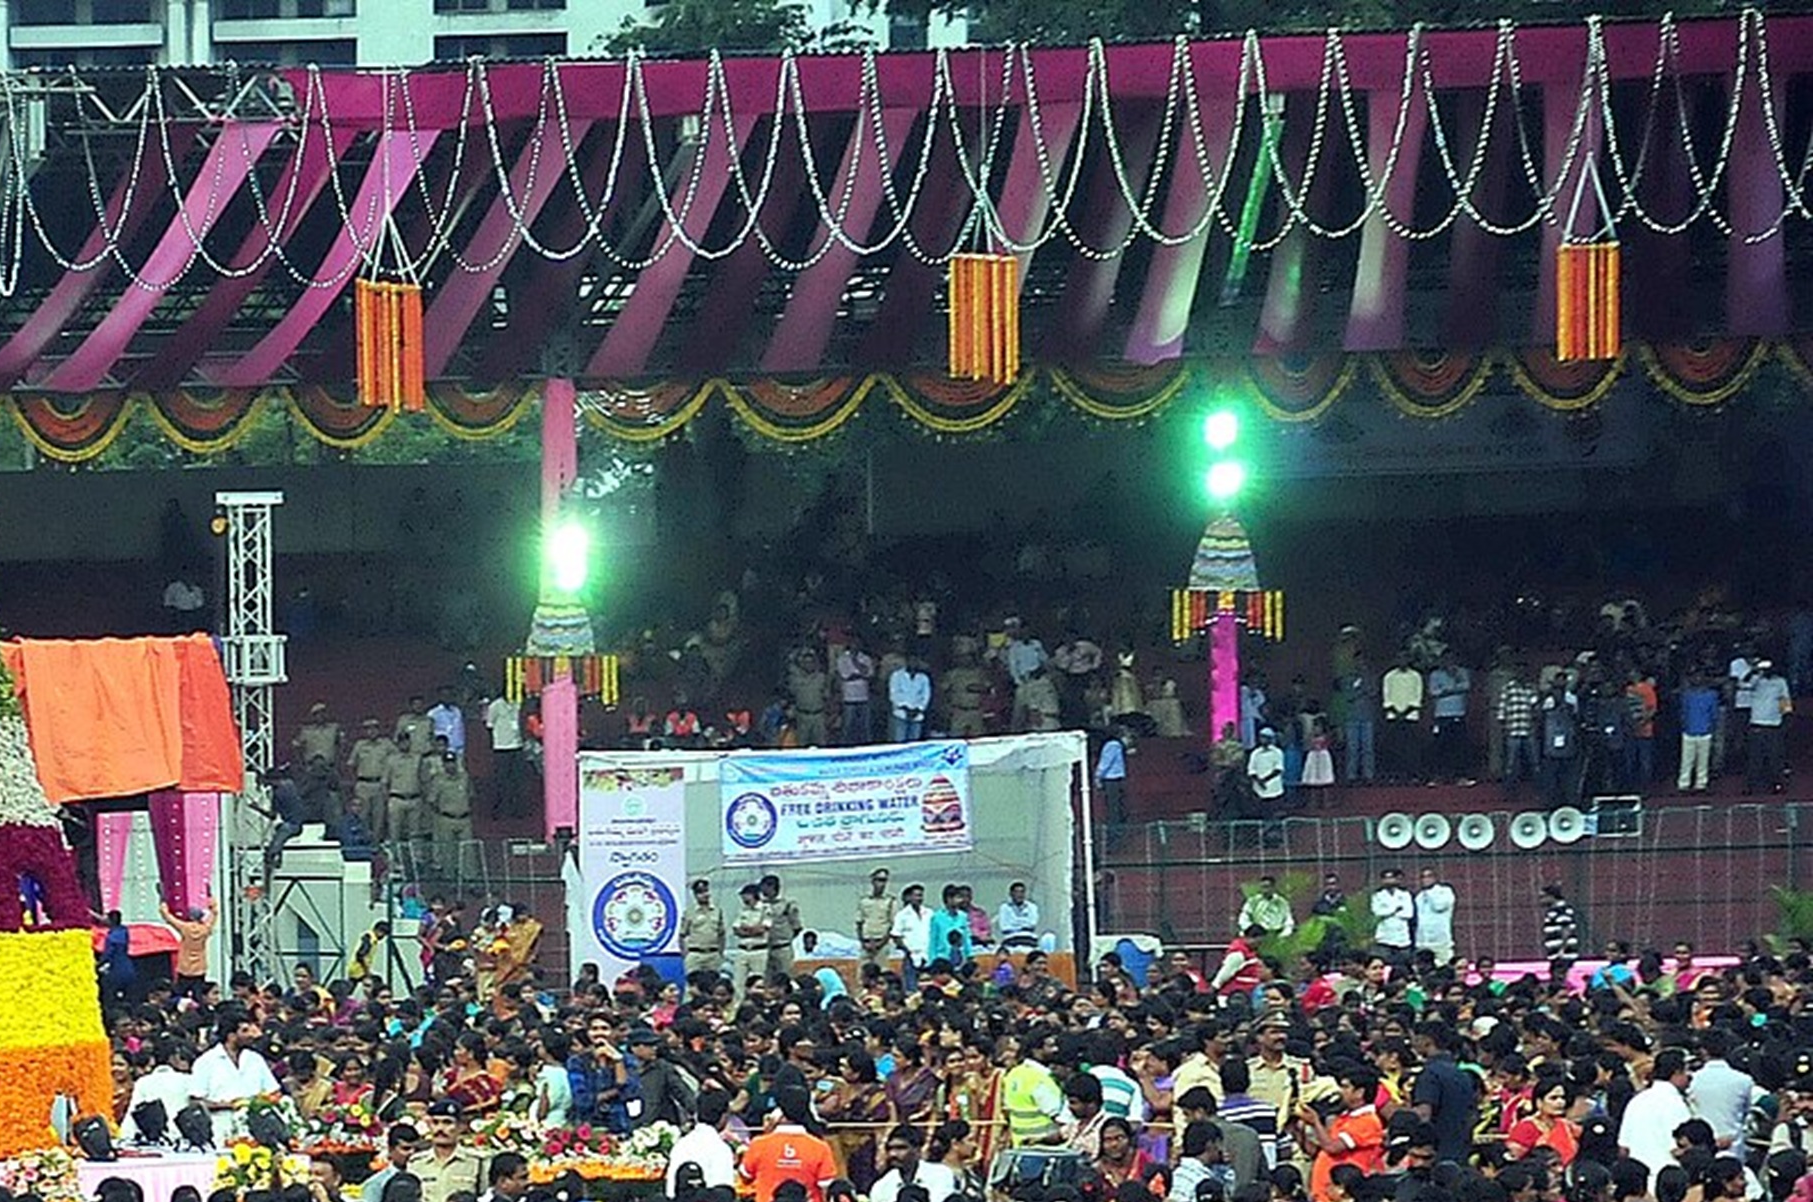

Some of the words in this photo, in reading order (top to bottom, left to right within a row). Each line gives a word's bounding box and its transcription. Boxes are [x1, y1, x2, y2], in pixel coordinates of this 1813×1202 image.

[780, 803, 811, 816] FREE
[815, 798, 874, 814] DRINKING
[878, 795, 919, 809] WATER
